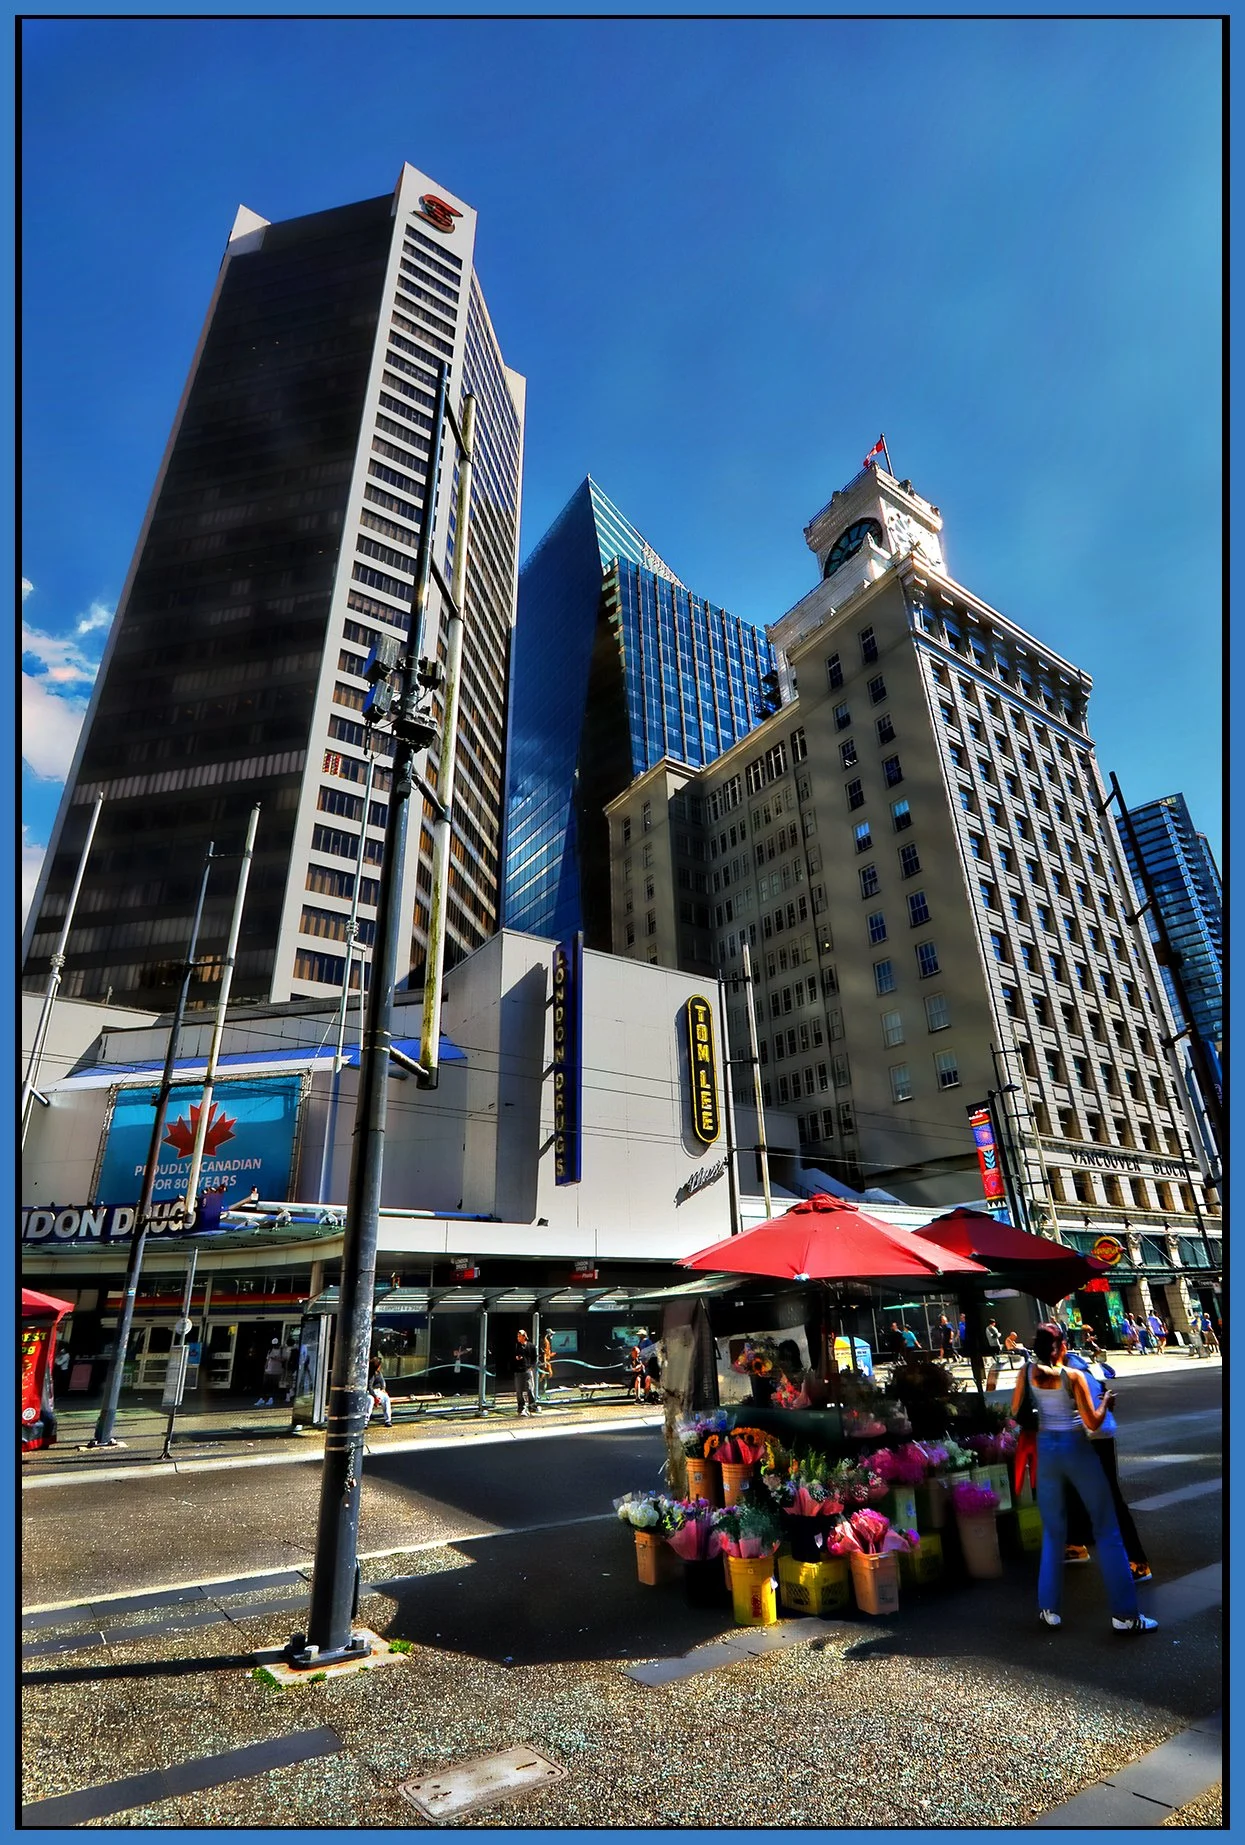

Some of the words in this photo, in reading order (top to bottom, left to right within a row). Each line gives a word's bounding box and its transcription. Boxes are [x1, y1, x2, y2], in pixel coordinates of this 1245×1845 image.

[555, 950, 565, 1063] LONDON
[694, 1004, 710, 1063] TOM
[699, 1069, 714, 1132] LEE
[555, 1072, 565, 1177] DRUGS
[134, 1162, 193, 1176] POUDLY
[200, 1158, 262, 1173] CANADIAN
[174, 1178, 188, 1189] 80
[198, 1175, 237, 1188] YEARS
[1071, 1150, 1141, 1172] VANCOUVER
[1152, 1161, 1187, 1178] BLOCK
[22, 1332, 47, 1342] EST
